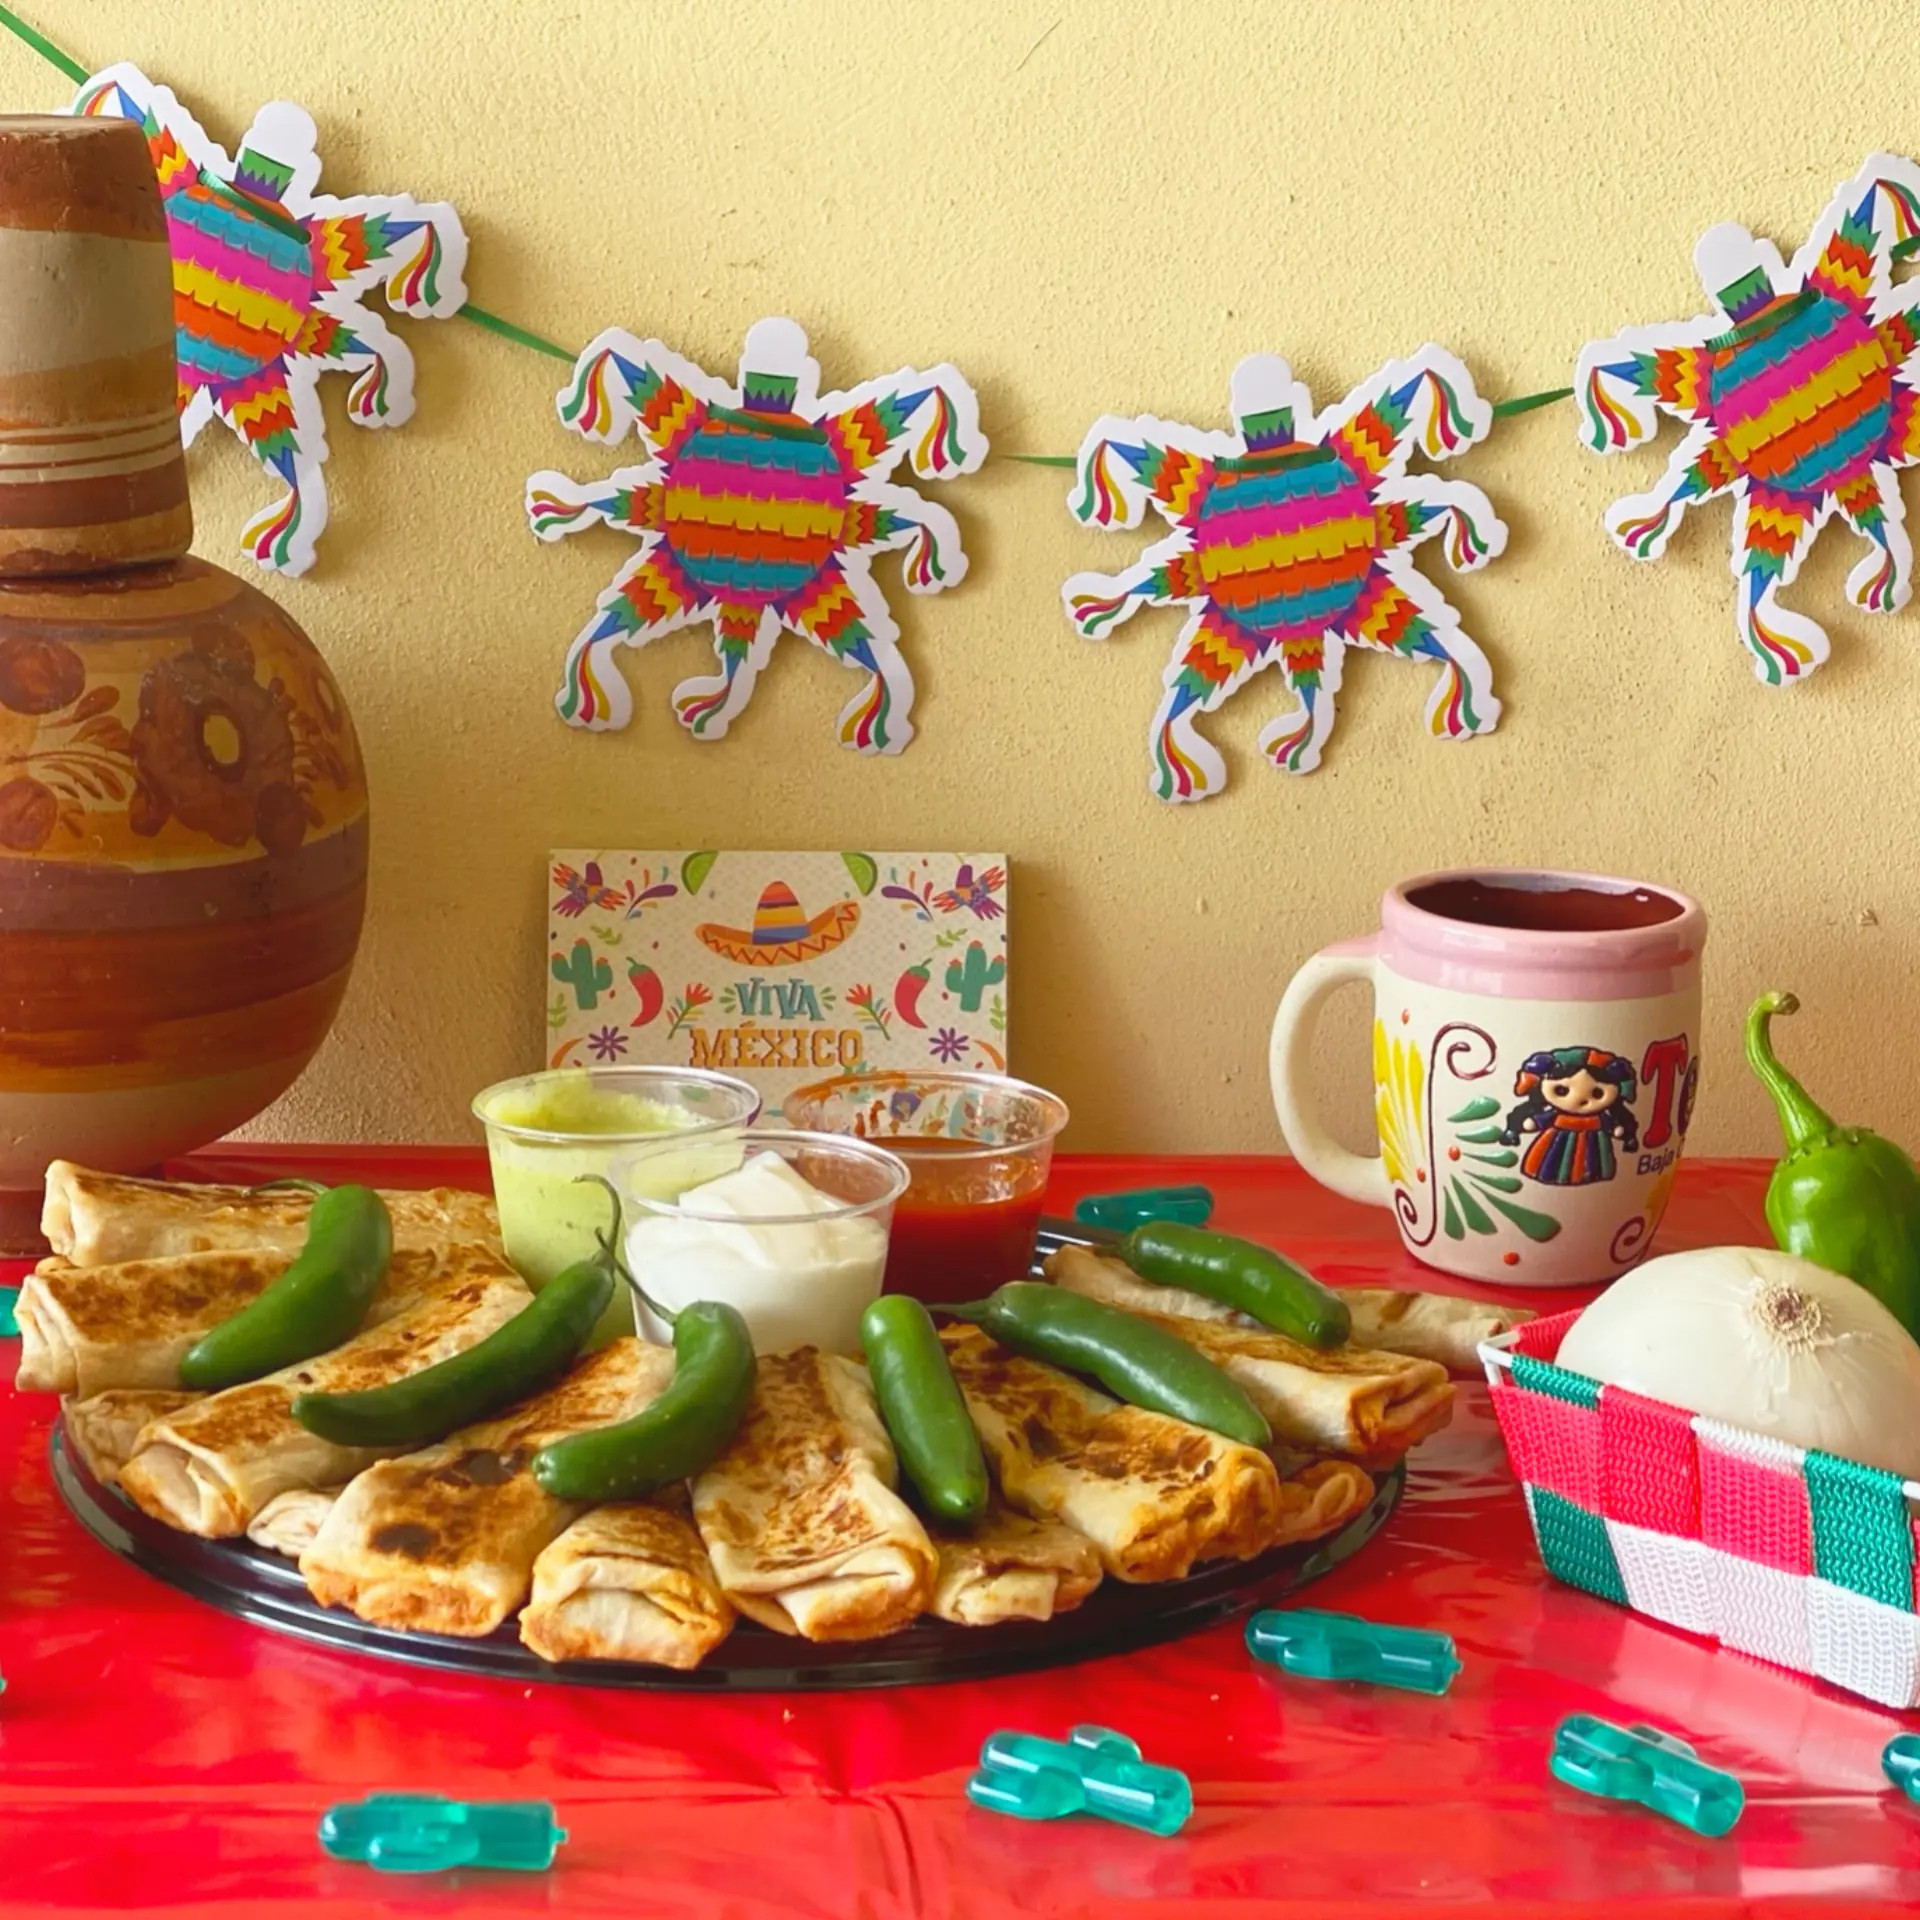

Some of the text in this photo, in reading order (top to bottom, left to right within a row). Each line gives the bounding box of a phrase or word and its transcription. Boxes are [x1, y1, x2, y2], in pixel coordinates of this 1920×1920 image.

[734, 976, 825, 1021] VIVA
[689, 1020, 863, 1068] MÉXICO
[1636, 1148, 1676, 1176] Baja
